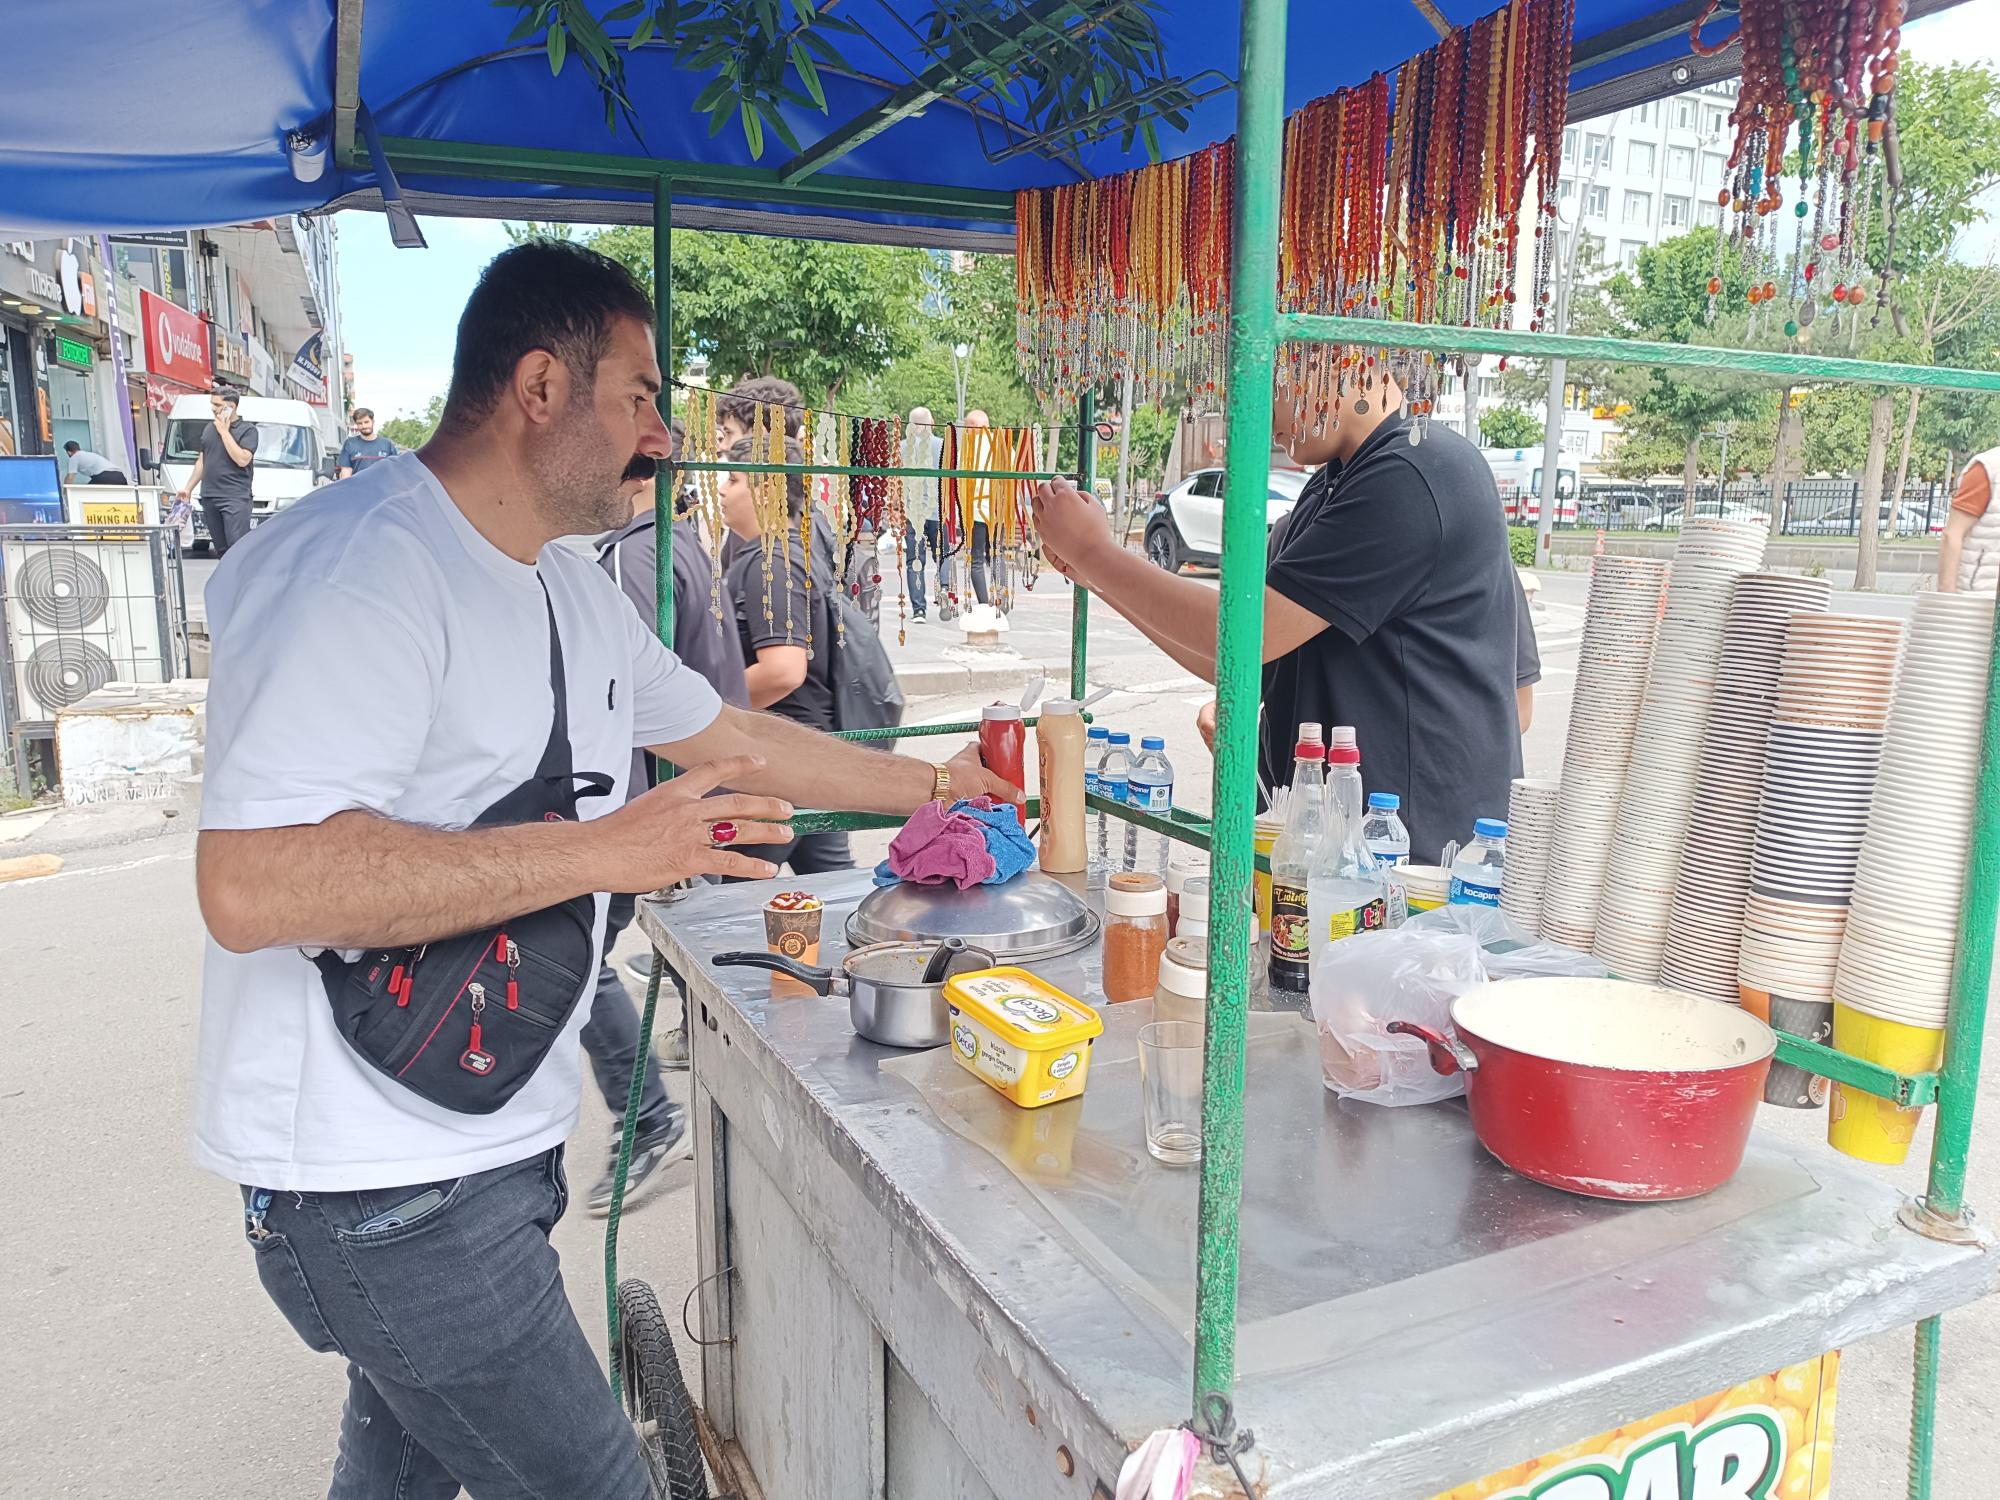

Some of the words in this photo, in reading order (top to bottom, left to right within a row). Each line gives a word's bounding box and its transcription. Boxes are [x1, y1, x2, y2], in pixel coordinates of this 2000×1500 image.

[172, 331, 203, 364] vodafone
[1012, 998, 1054, 1020] Becel
[955, 1030, 975, 1053] Becel
